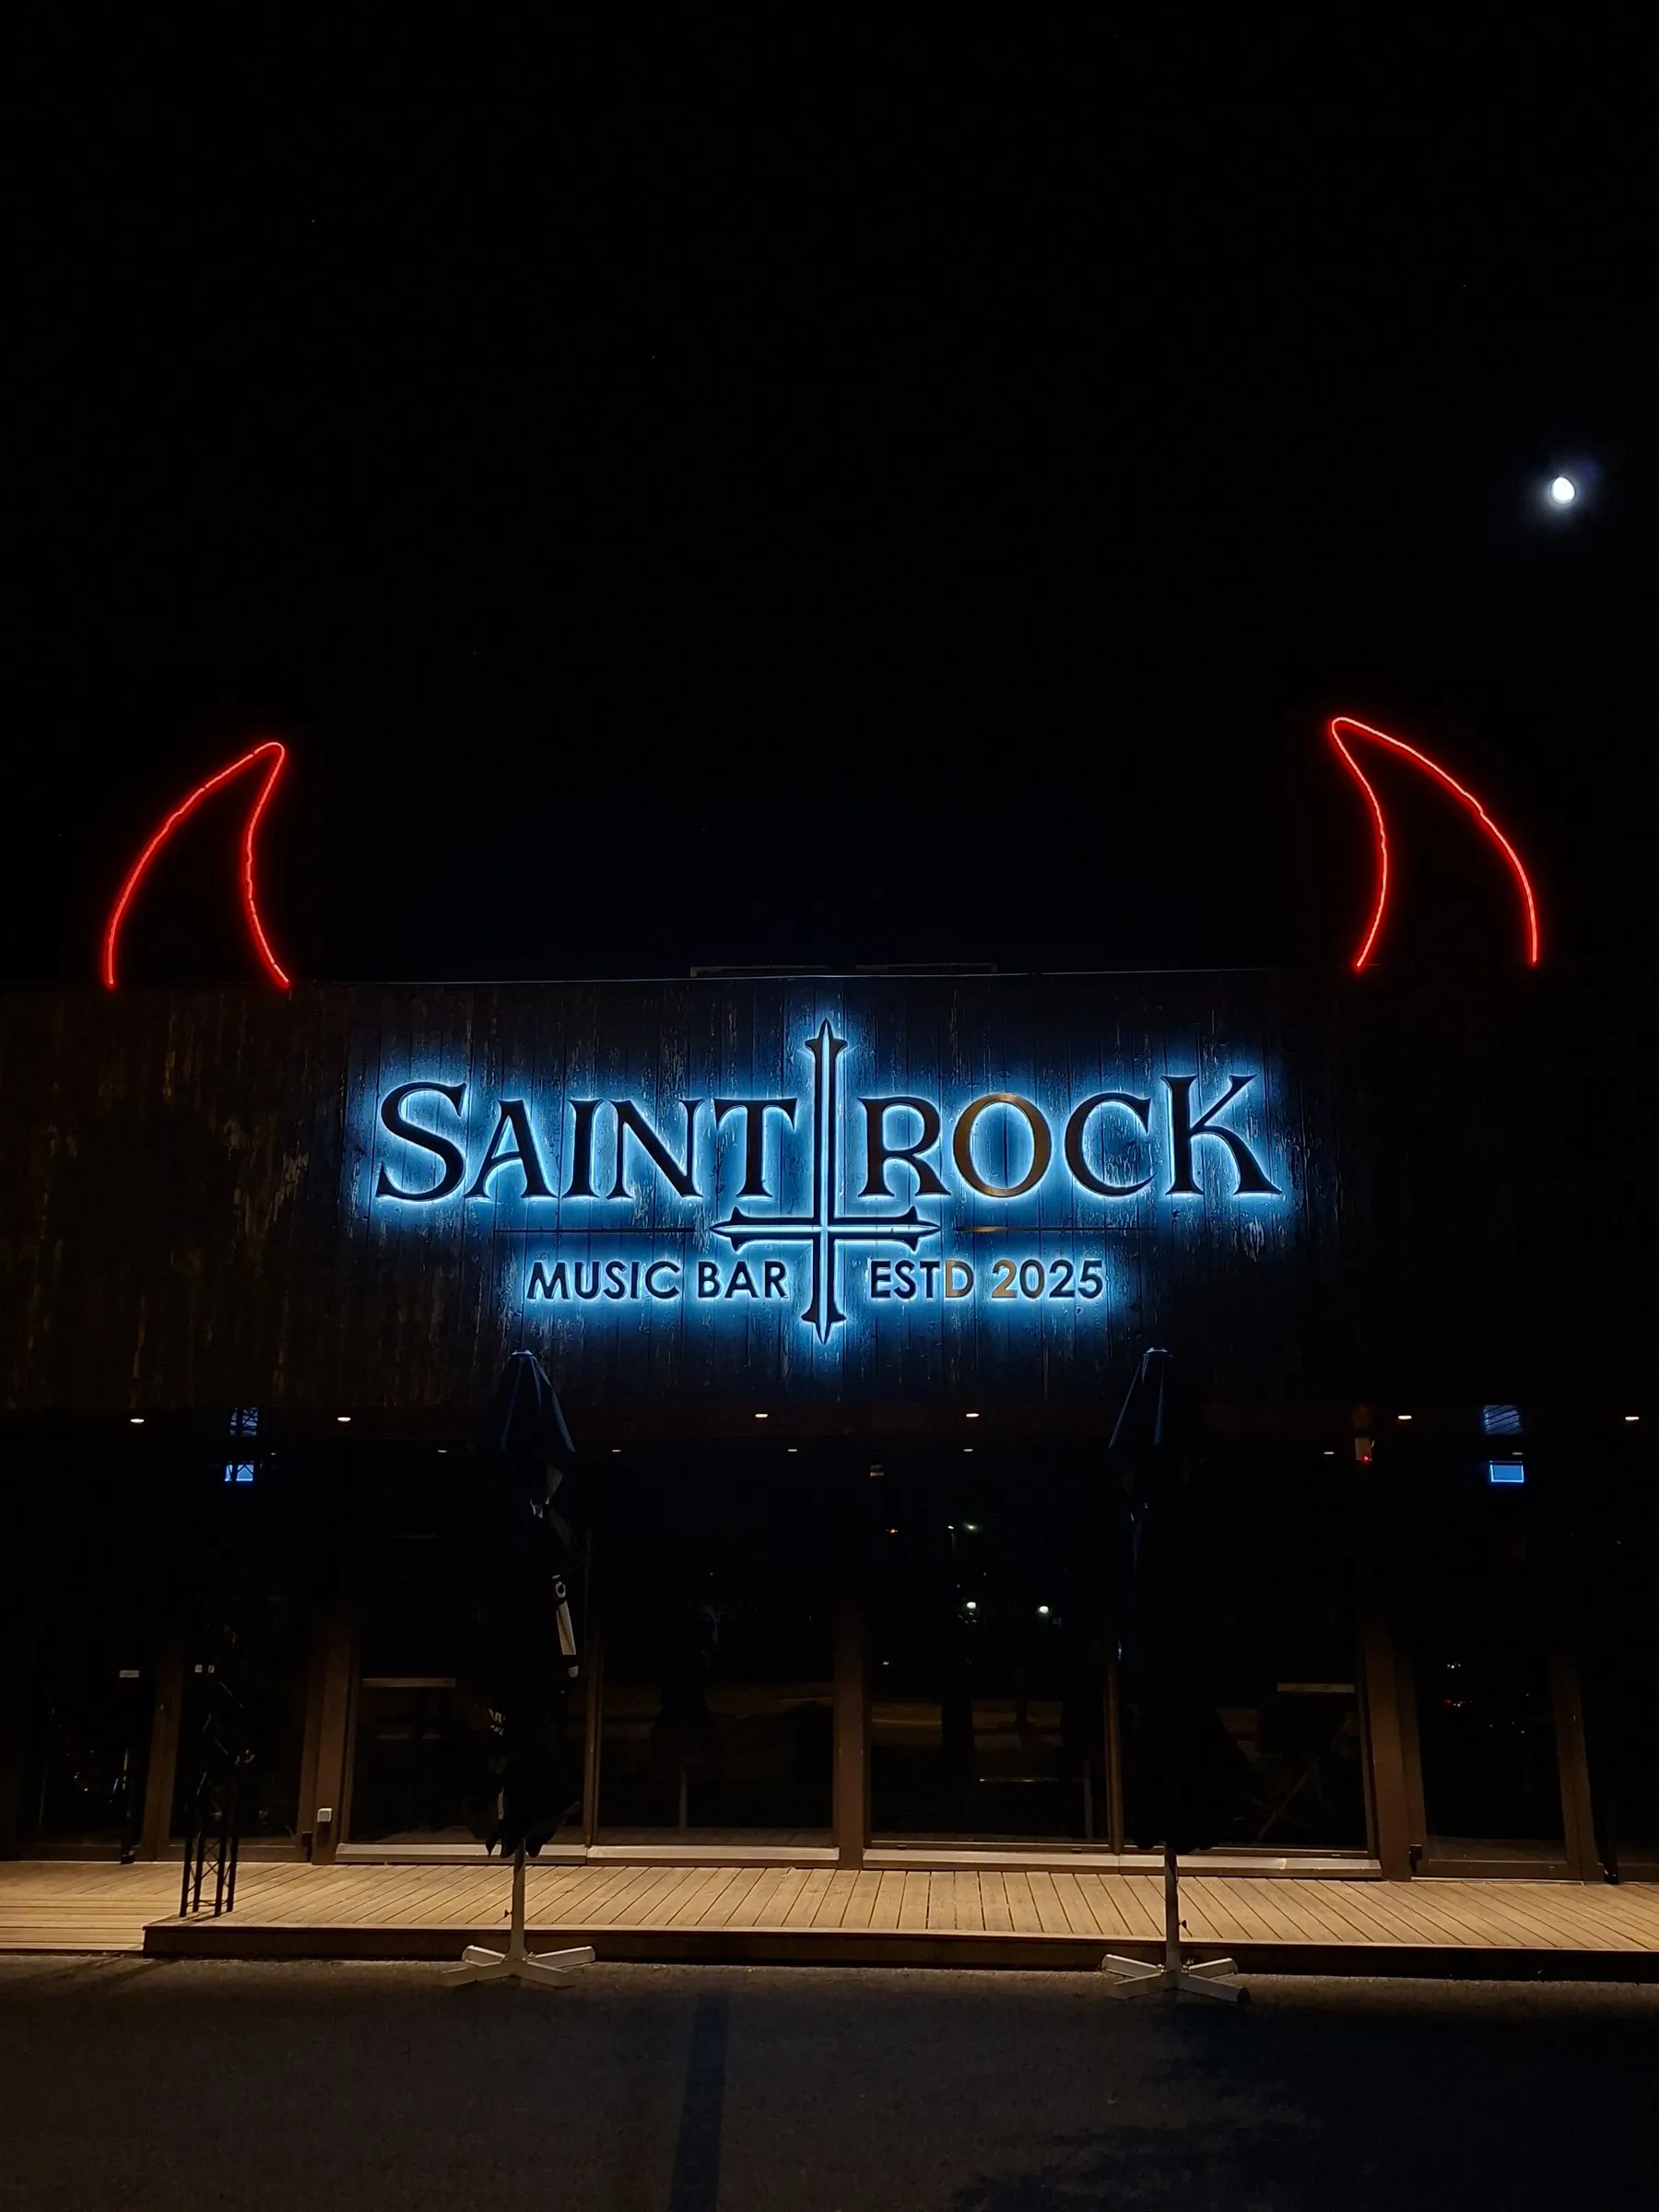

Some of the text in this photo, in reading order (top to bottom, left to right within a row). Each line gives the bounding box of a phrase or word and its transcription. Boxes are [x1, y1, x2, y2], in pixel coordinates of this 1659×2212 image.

[374, 1074, 1284, 1200] SAINT ROCK
[526, 1261, 789, 1300] MUSIC BAR
[870, 1259, 1103, 1300] ESTD 2025
